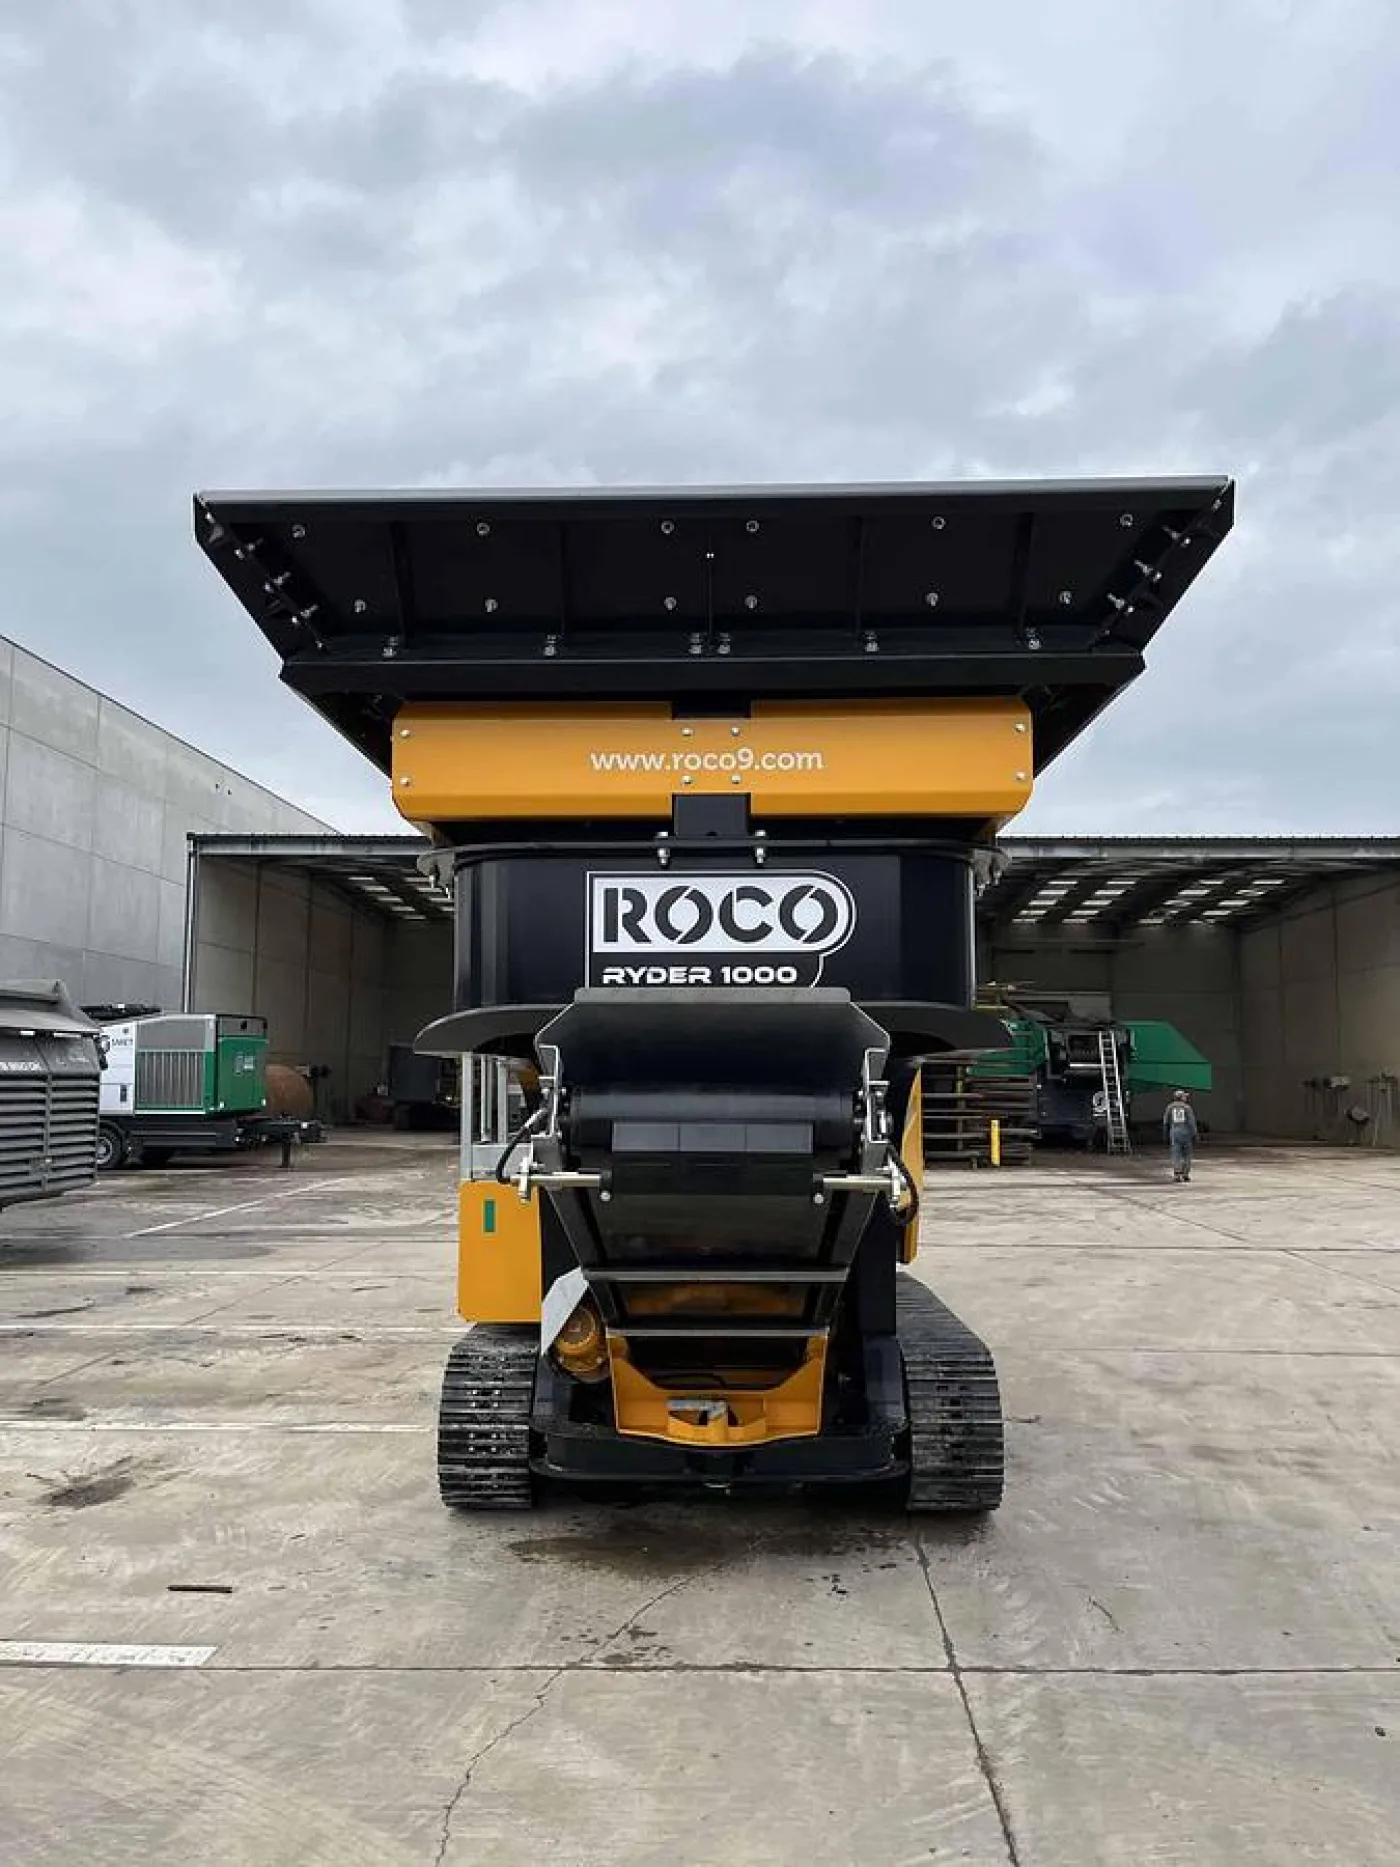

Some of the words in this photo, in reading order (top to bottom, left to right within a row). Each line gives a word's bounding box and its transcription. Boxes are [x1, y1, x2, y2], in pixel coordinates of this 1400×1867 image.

[590, 747, 825, 771] www.roco9.com
[602, 884, 839, 945] ROCO
[602, 966, 712, 985] RYDER
[721, 966, 798, 985] 1000
